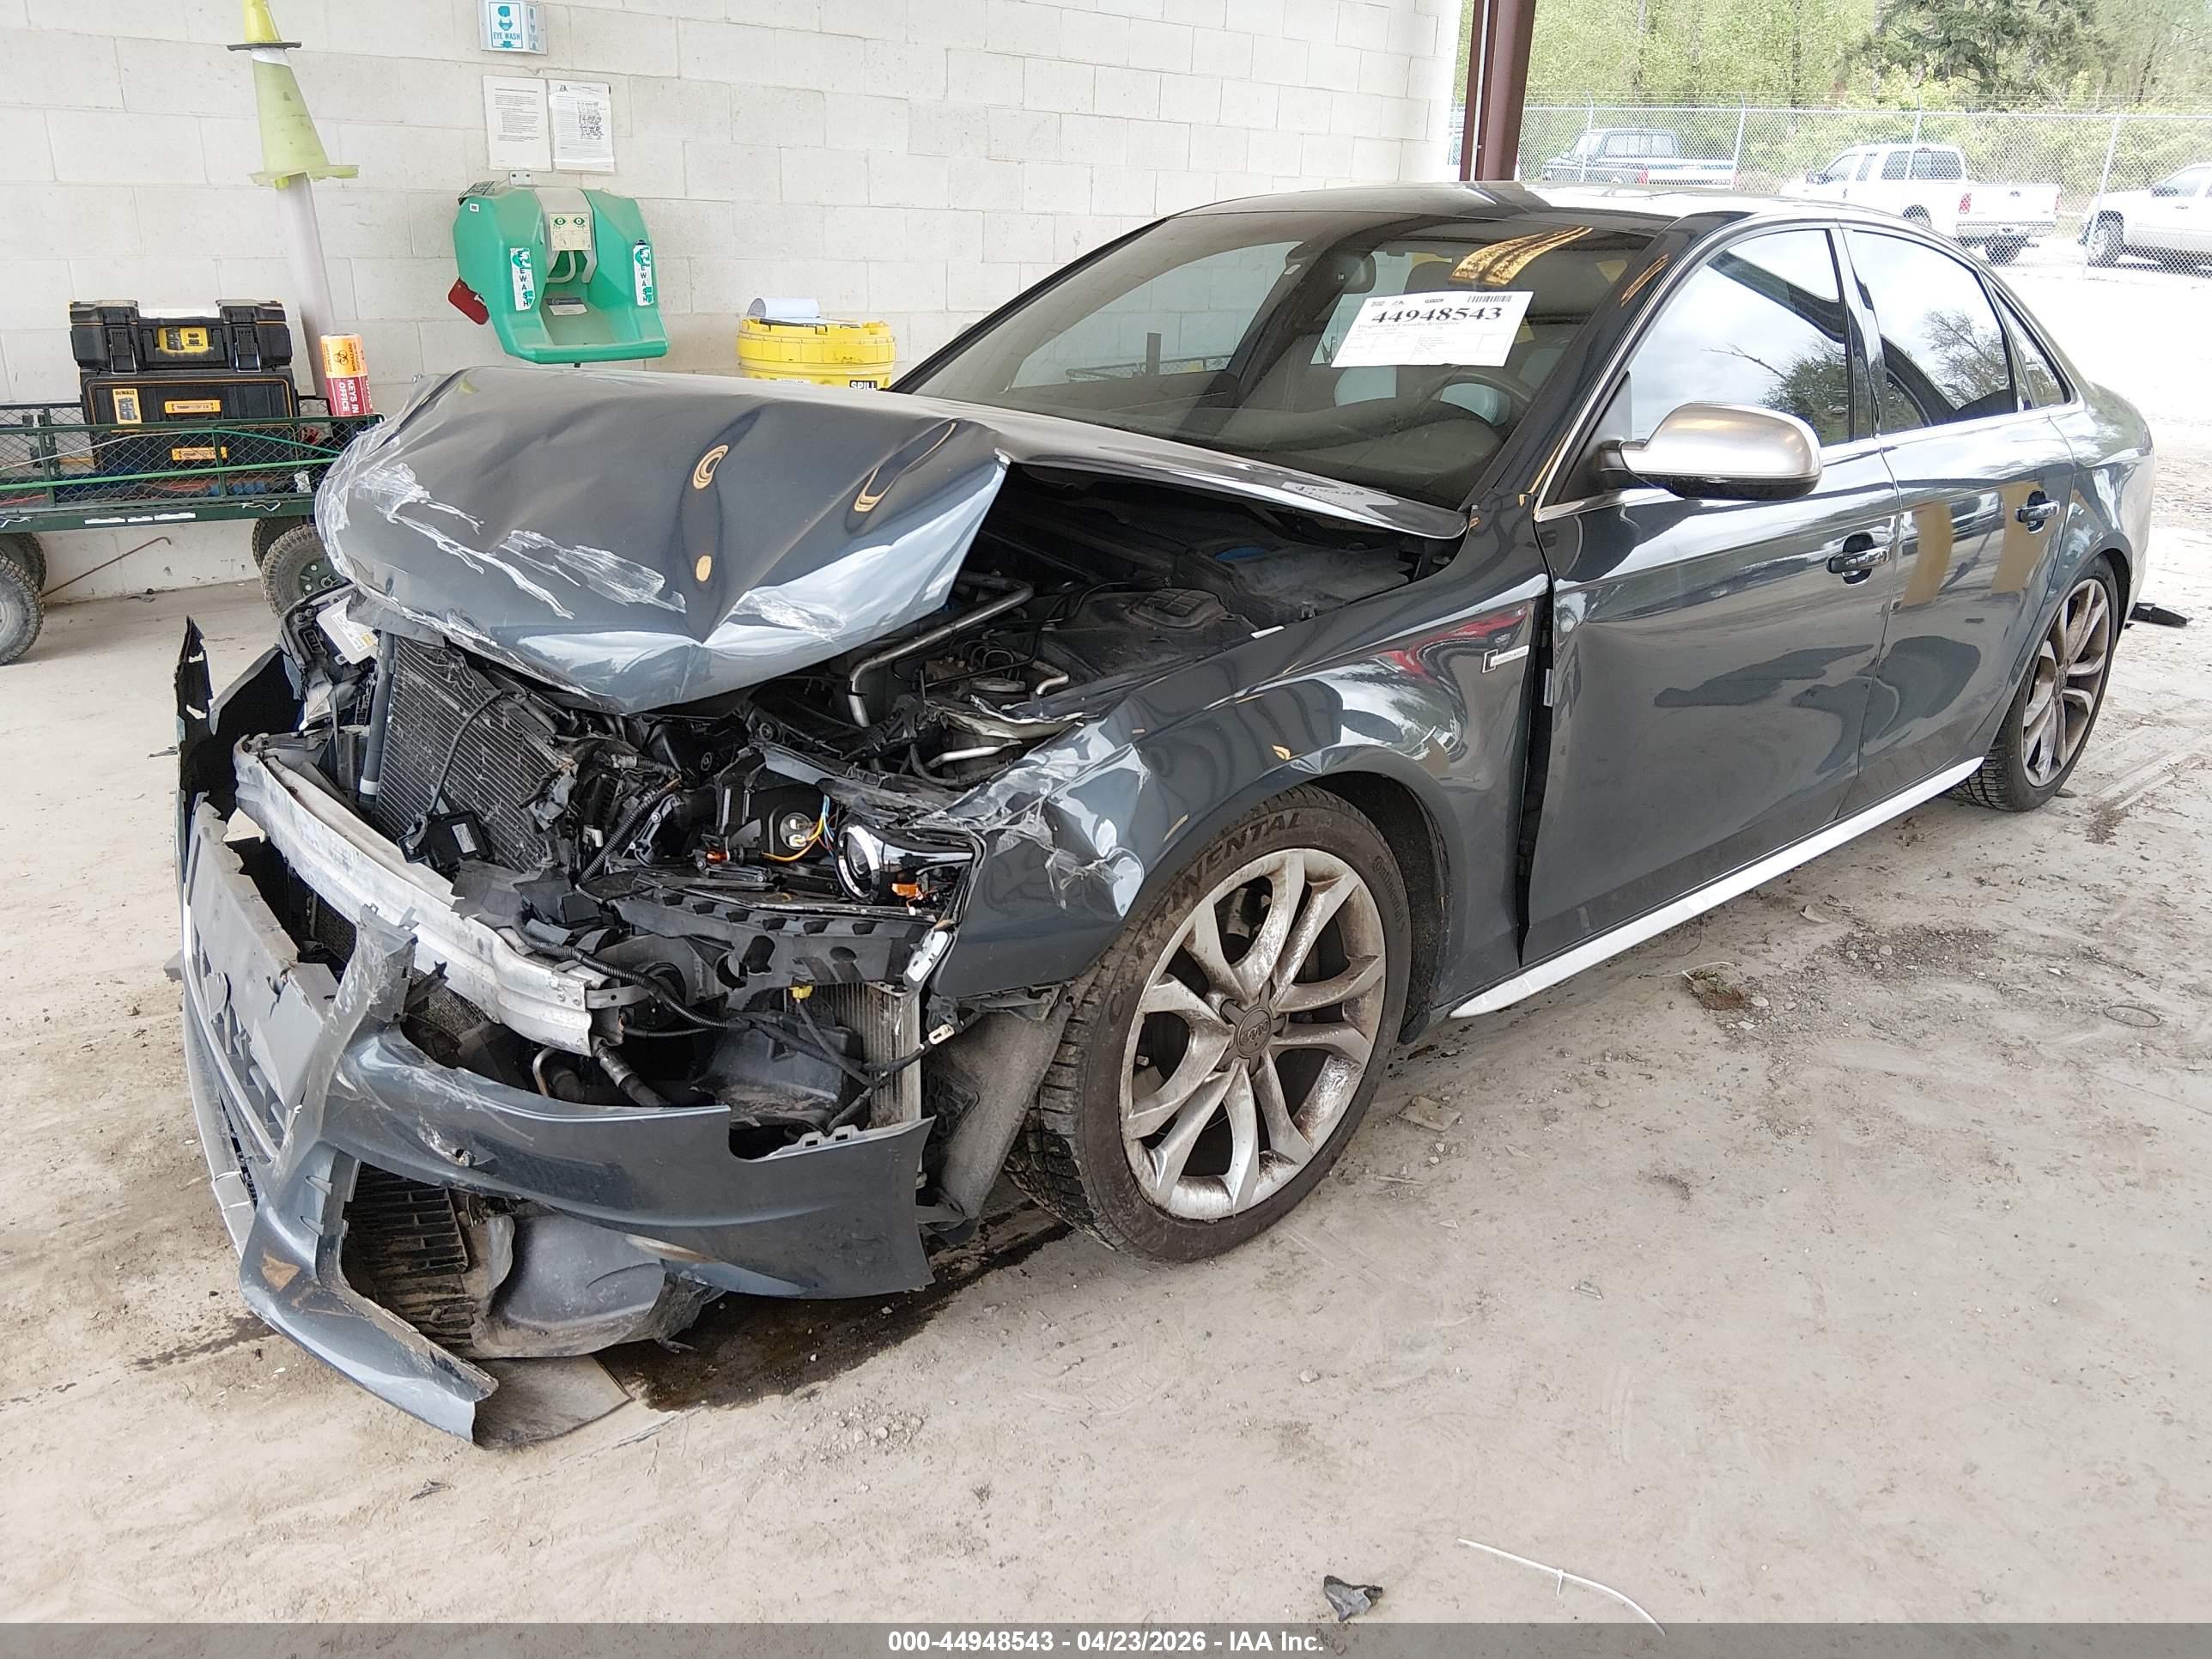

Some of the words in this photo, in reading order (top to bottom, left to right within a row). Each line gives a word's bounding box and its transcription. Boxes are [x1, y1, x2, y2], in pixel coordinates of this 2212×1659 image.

[1371, 307, 1503, 324] 44948543
[347, 379, 358, 403] KEYS
[850, 381, 877, 391] SPILL
[338, 381, 350, 412] OFFICE
[351, 404, 360, 414] IN
